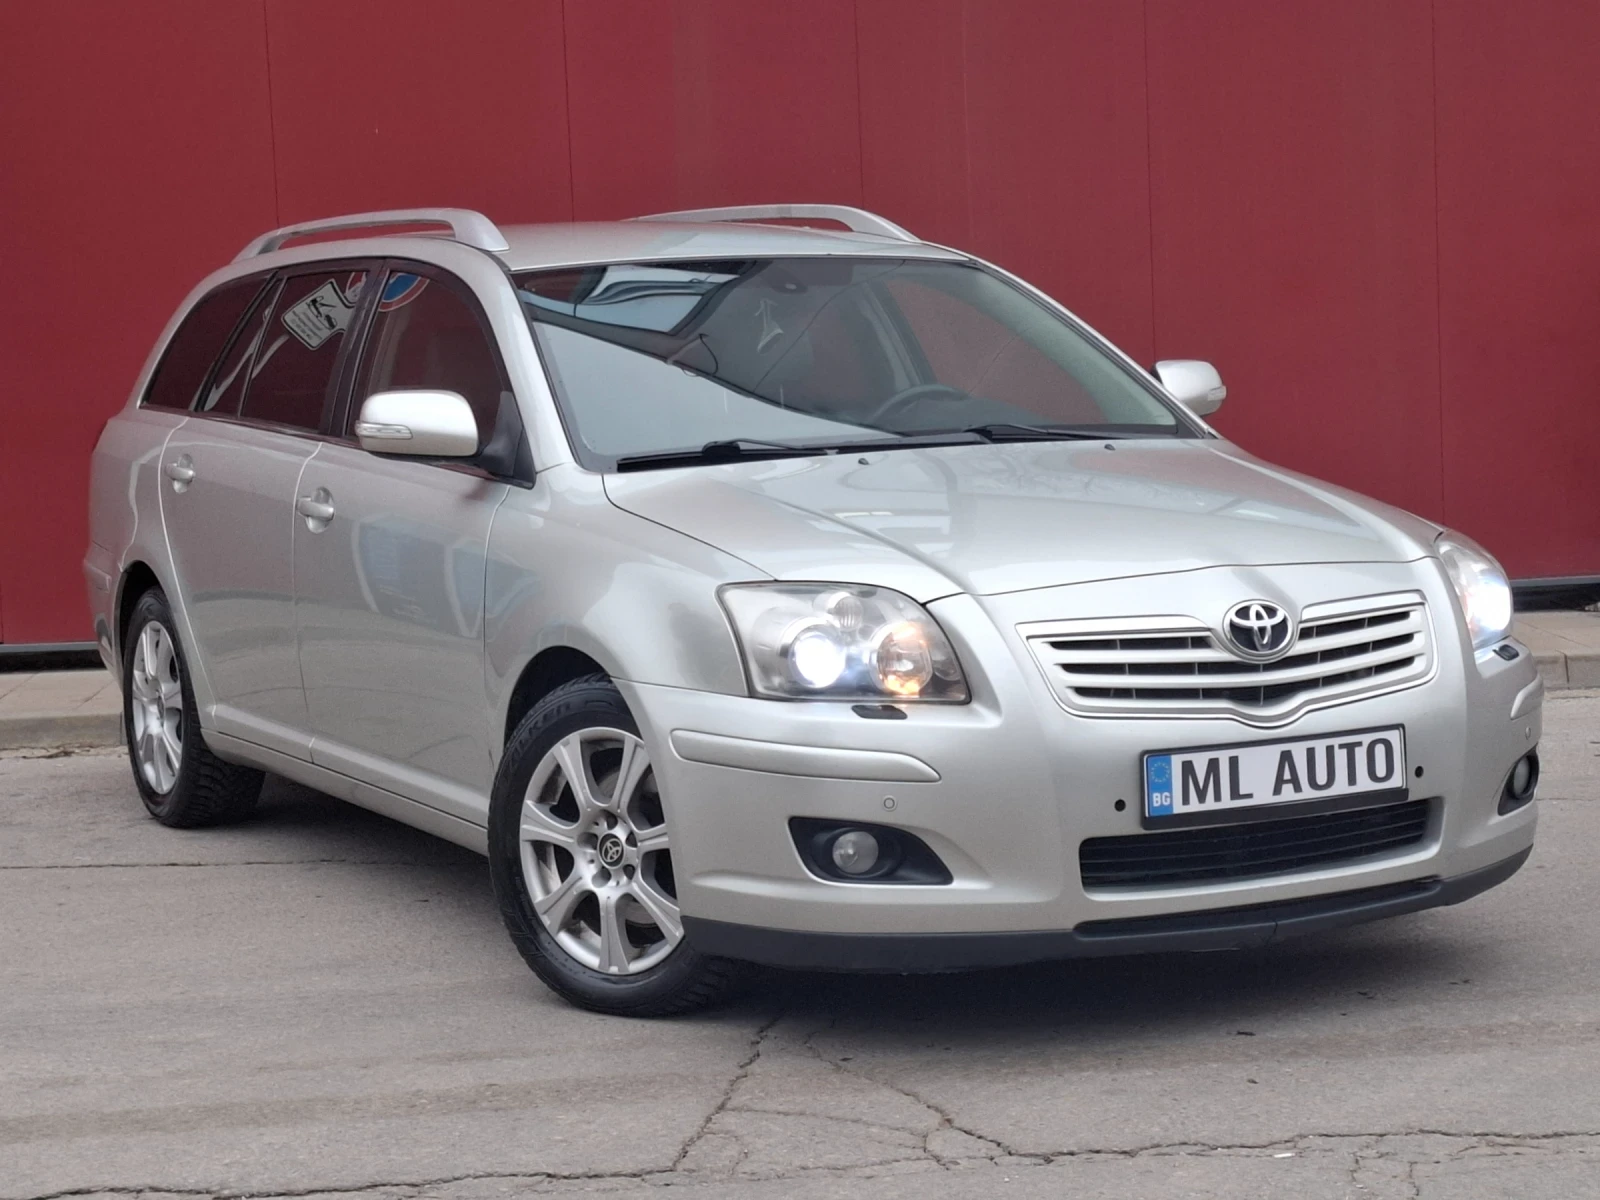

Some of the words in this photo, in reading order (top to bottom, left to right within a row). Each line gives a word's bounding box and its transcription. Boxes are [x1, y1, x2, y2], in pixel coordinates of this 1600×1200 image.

[1181, 755, 1253, 806] ML
[1272, 737, 1395, 796] AUTO
[1152, 791, 1171, 807] BG
